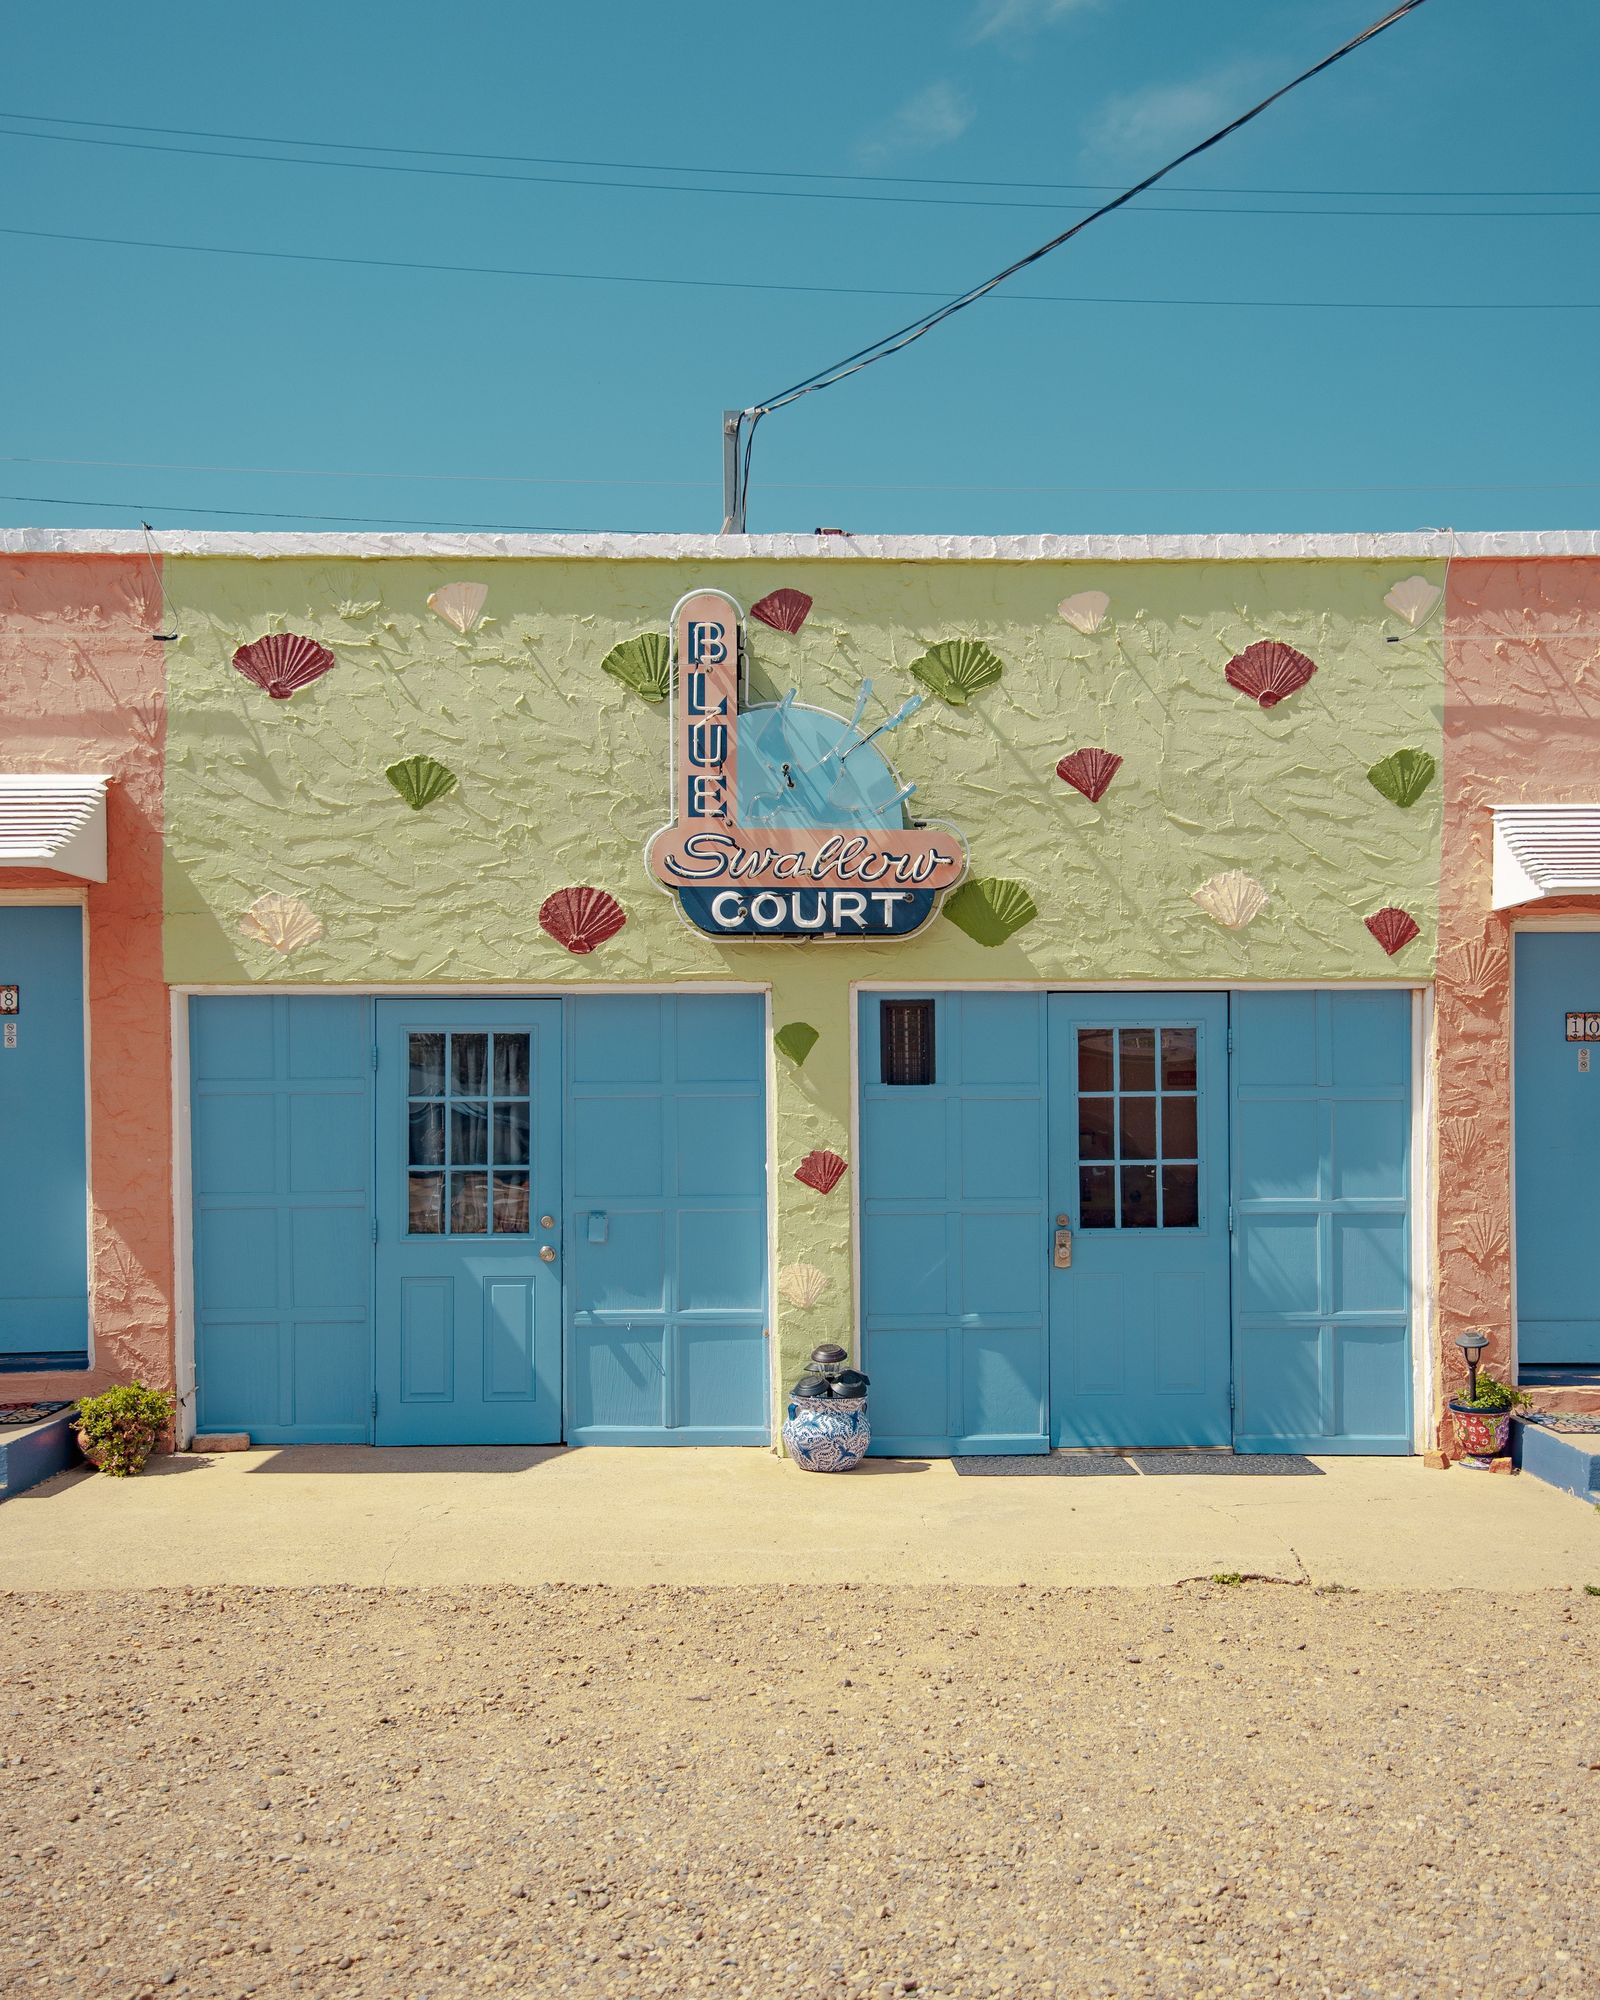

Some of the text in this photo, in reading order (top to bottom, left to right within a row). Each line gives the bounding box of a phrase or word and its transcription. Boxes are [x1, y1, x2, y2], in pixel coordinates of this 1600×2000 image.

[688, 622, 728, 818] BLUE
[664, 834, 953, 883] Swallow
[711, 890, 906, 929] COURT
[4, 992, 13, 1006] 8
[1572, 1020, 1600, 1034] 10
